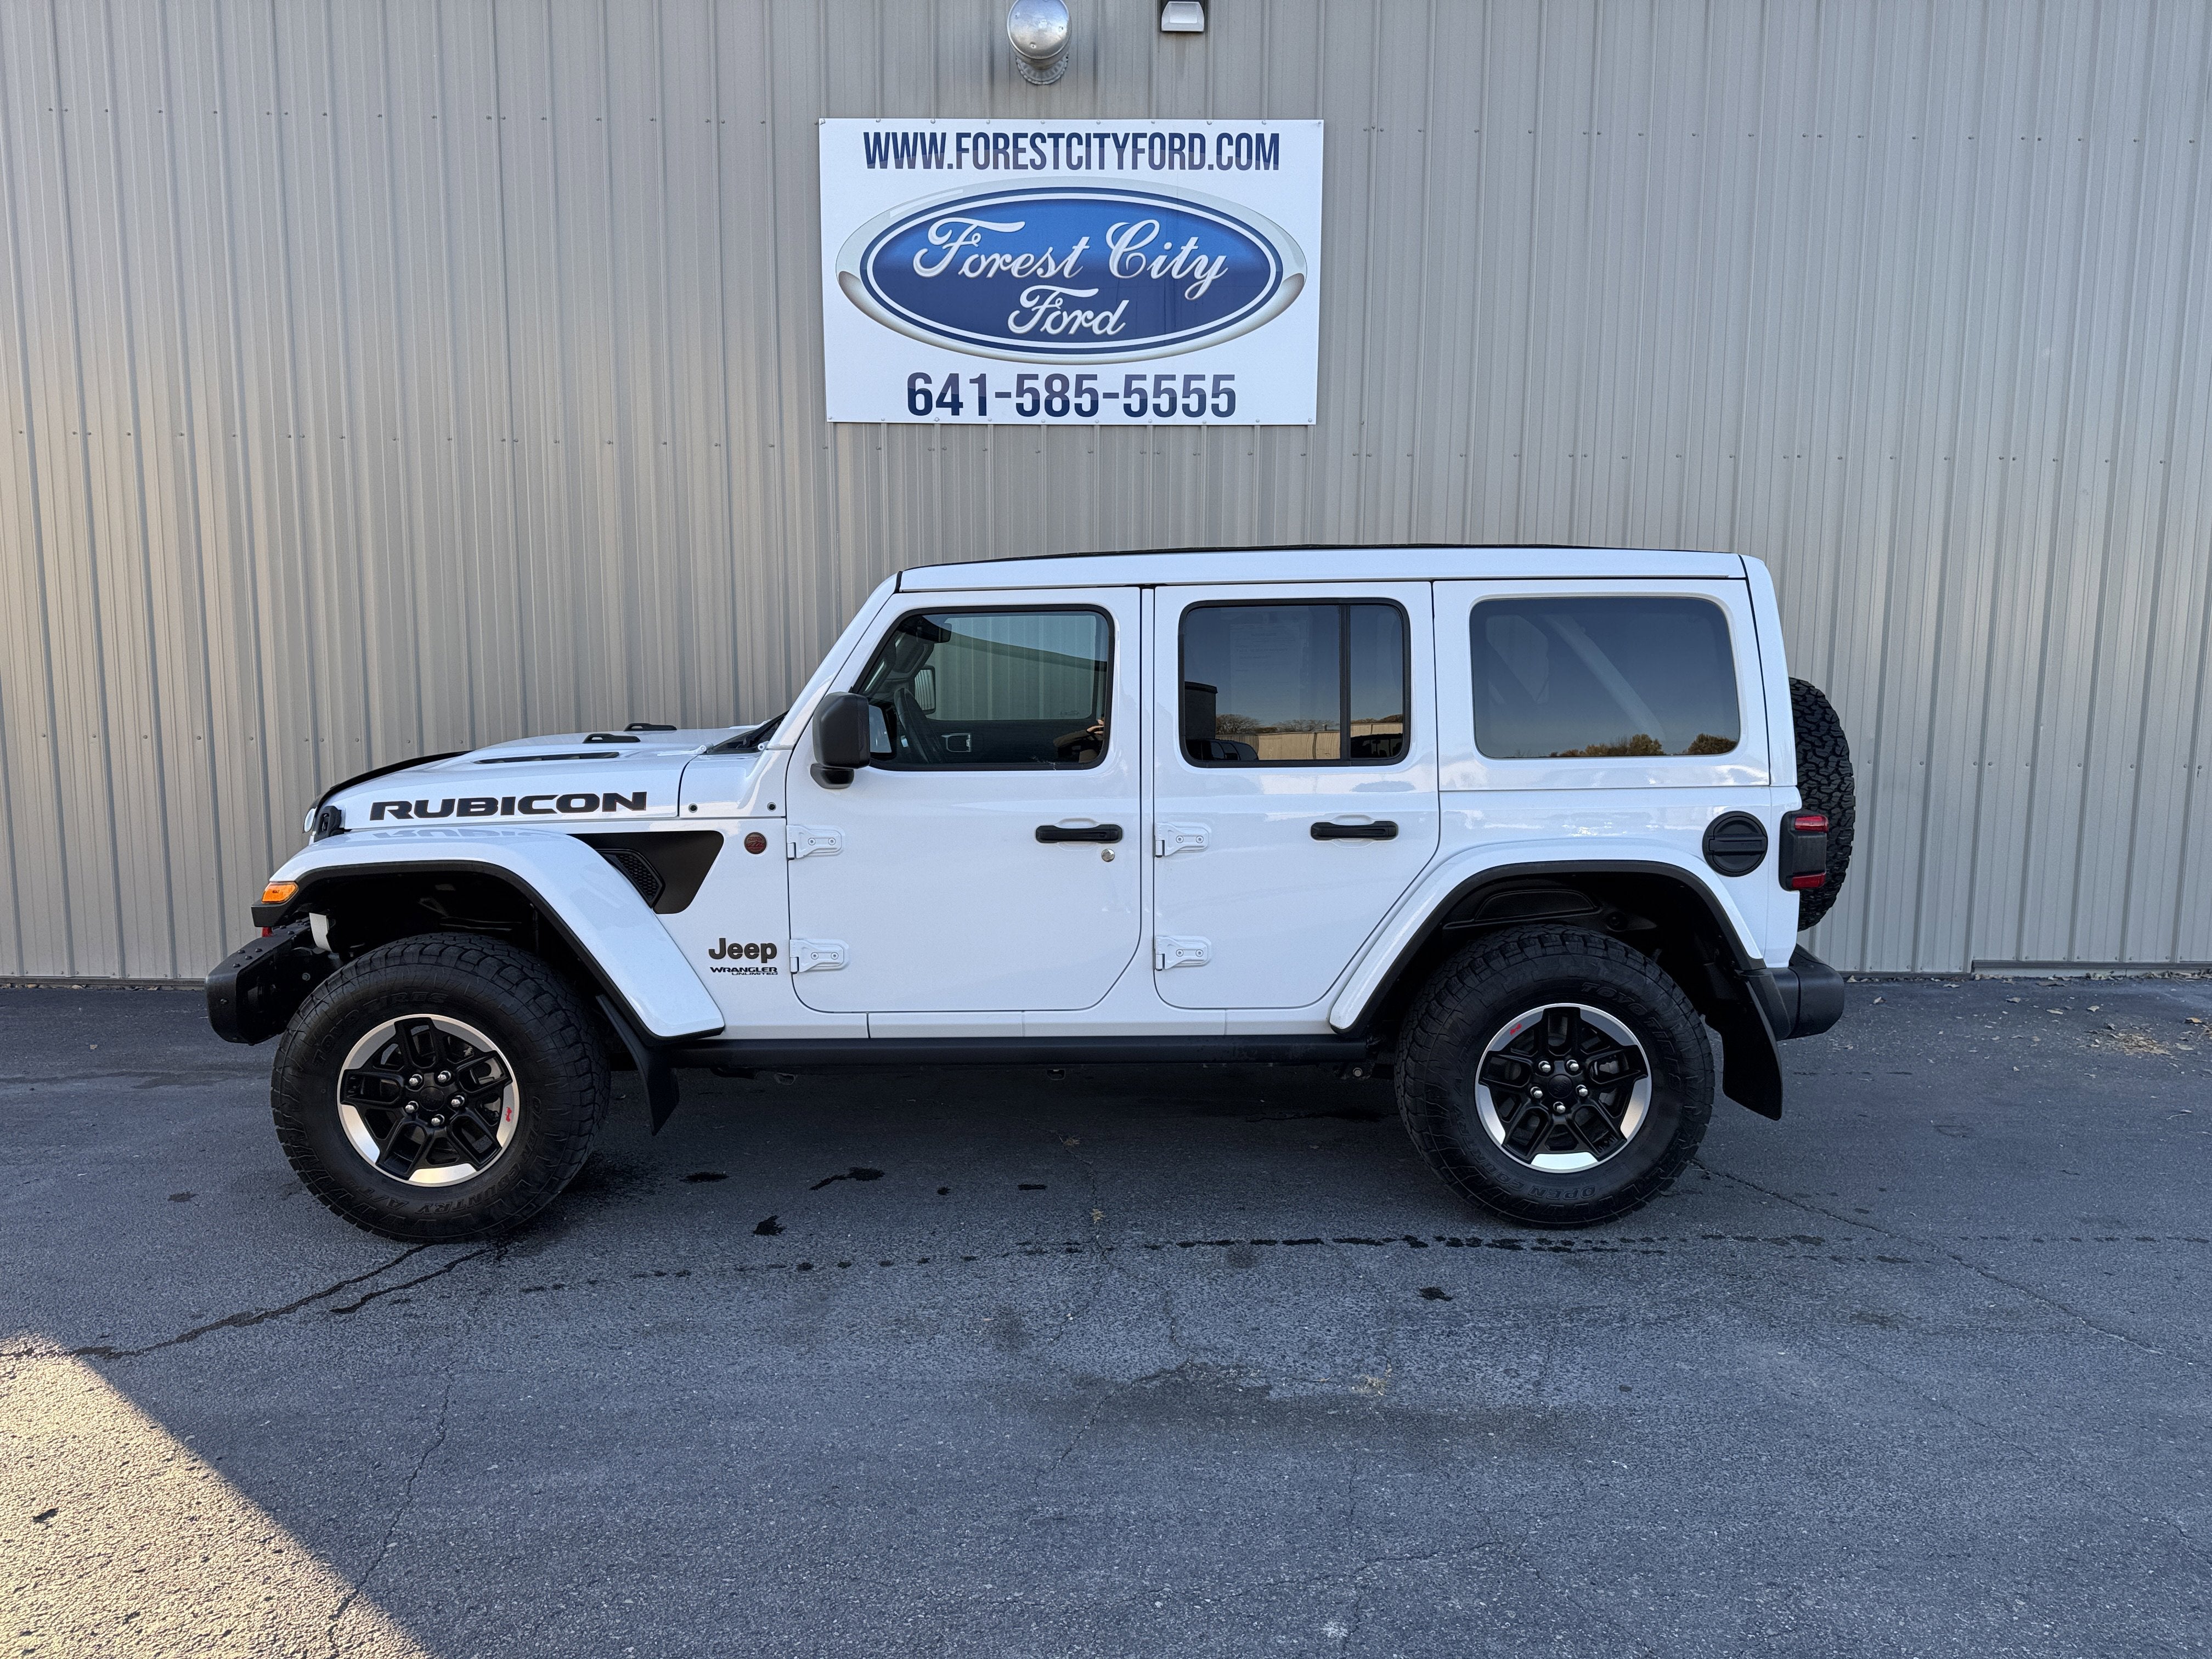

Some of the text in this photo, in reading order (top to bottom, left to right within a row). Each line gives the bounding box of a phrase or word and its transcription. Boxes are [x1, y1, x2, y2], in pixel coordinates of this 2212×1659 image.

[864, 132, 1279, 171] WWW.FORESTCITYFORD.COM
[913, 217, 1228, 301] Forest City
[1008, 285, 1128, 336] Ford
[907, 372, 1236, 417] 641-585-5555
[370, 791, 647, 821] RUBICON
[708, 938, 777, 963] Jeep
[1581, 981, 1648, 1015] TOYO
[415, 1162, 521, 1215] COUNTRY
[1527, 1184, 1596, 1200] OPEN
